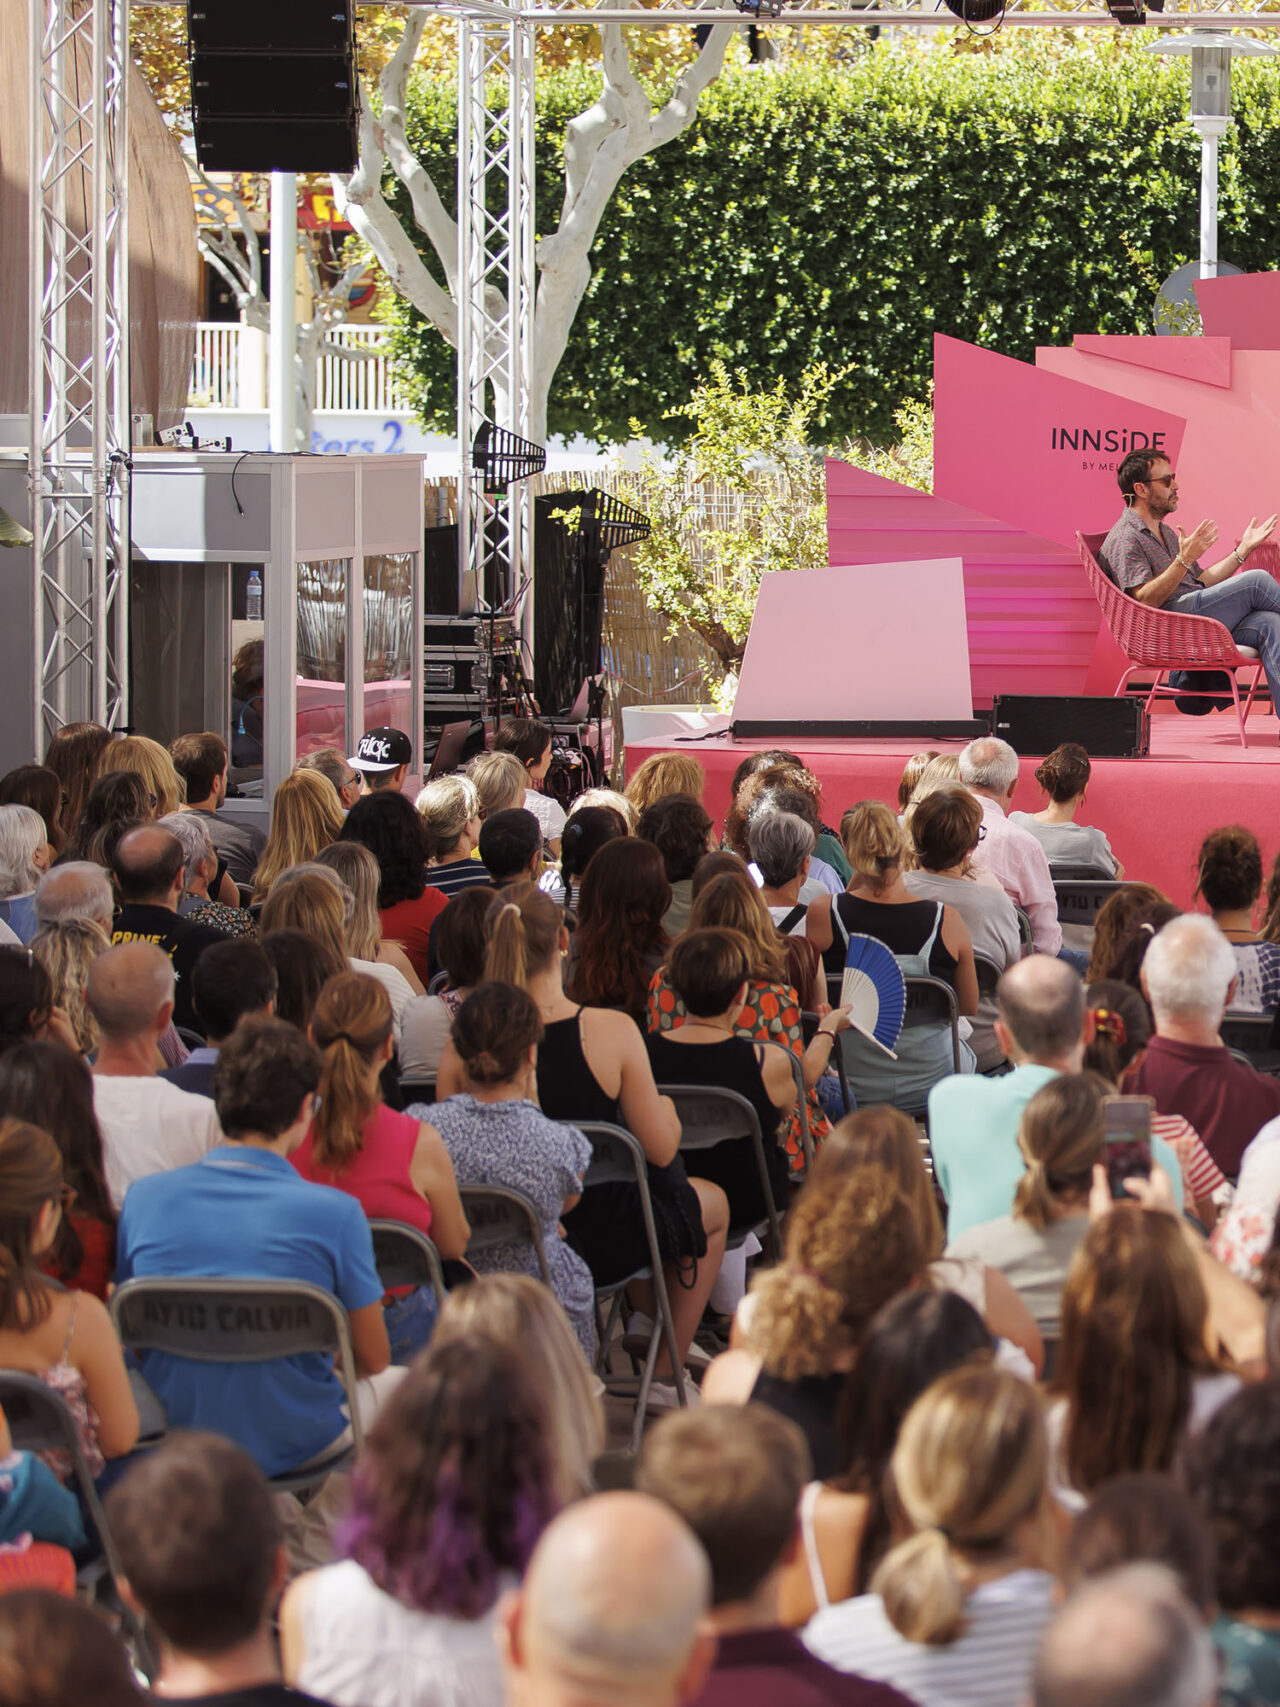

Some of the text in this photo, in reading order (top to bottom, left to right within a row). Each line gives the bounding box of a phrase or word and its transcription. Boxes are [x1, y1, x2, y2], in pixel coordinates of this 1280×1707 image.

[382, 420, 405, 453] 2
[1082, 461, 1119, 472] BY MEL
